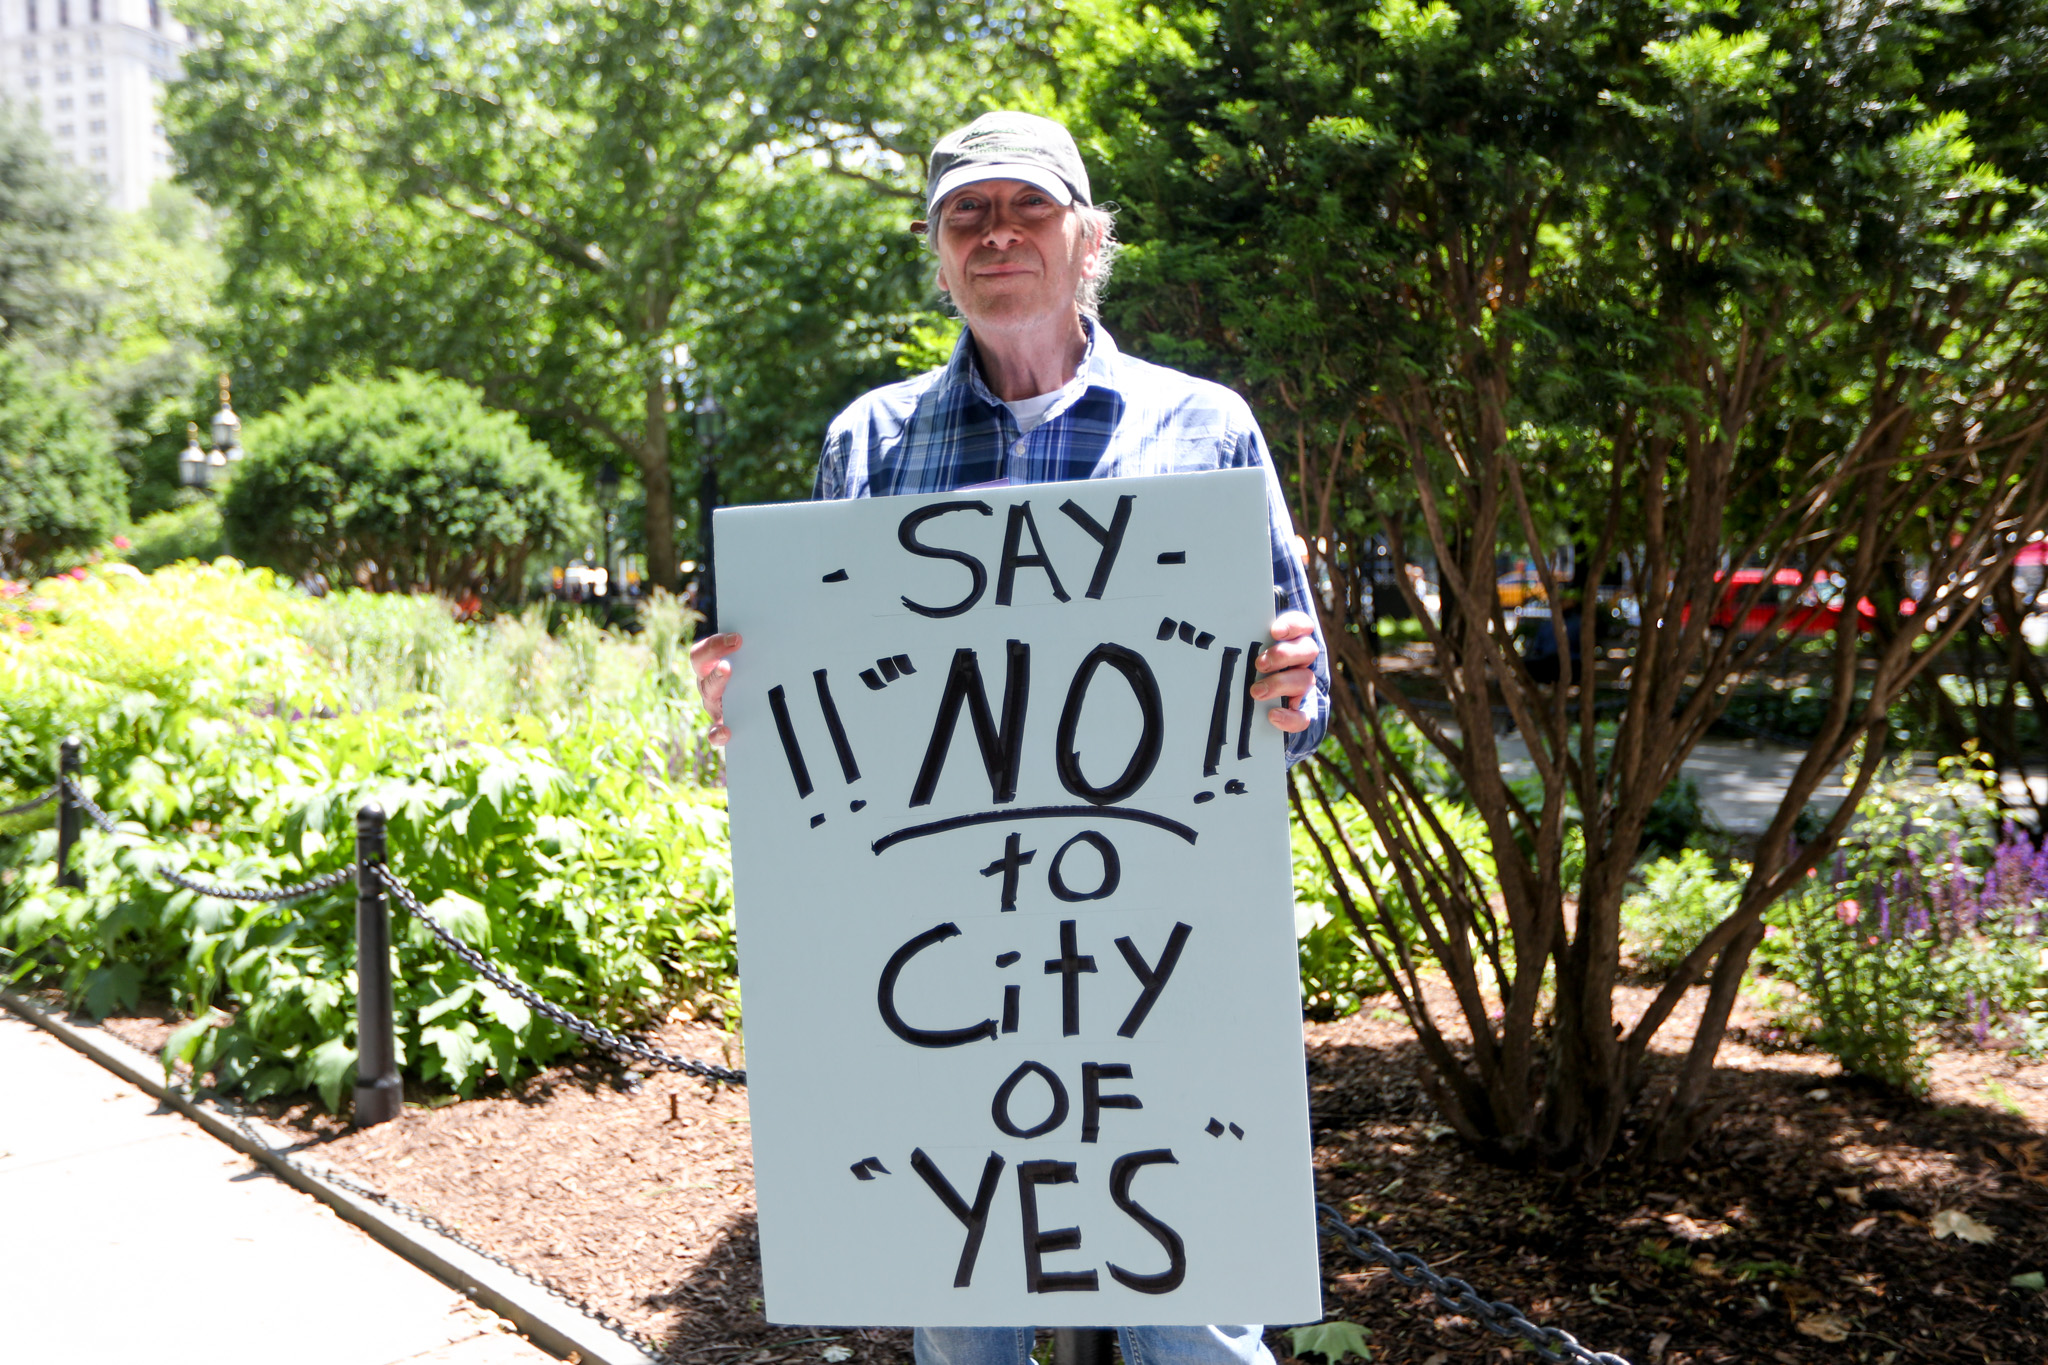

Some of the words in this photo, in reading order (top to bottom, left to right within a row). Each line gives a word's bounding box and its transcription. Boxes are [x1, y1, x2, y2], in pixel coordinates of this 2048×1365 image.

[897, 494, 1138, 619] SAY
[877, 919, 1193, 1049] City
[991, 1060, 1144, 1144] OF
